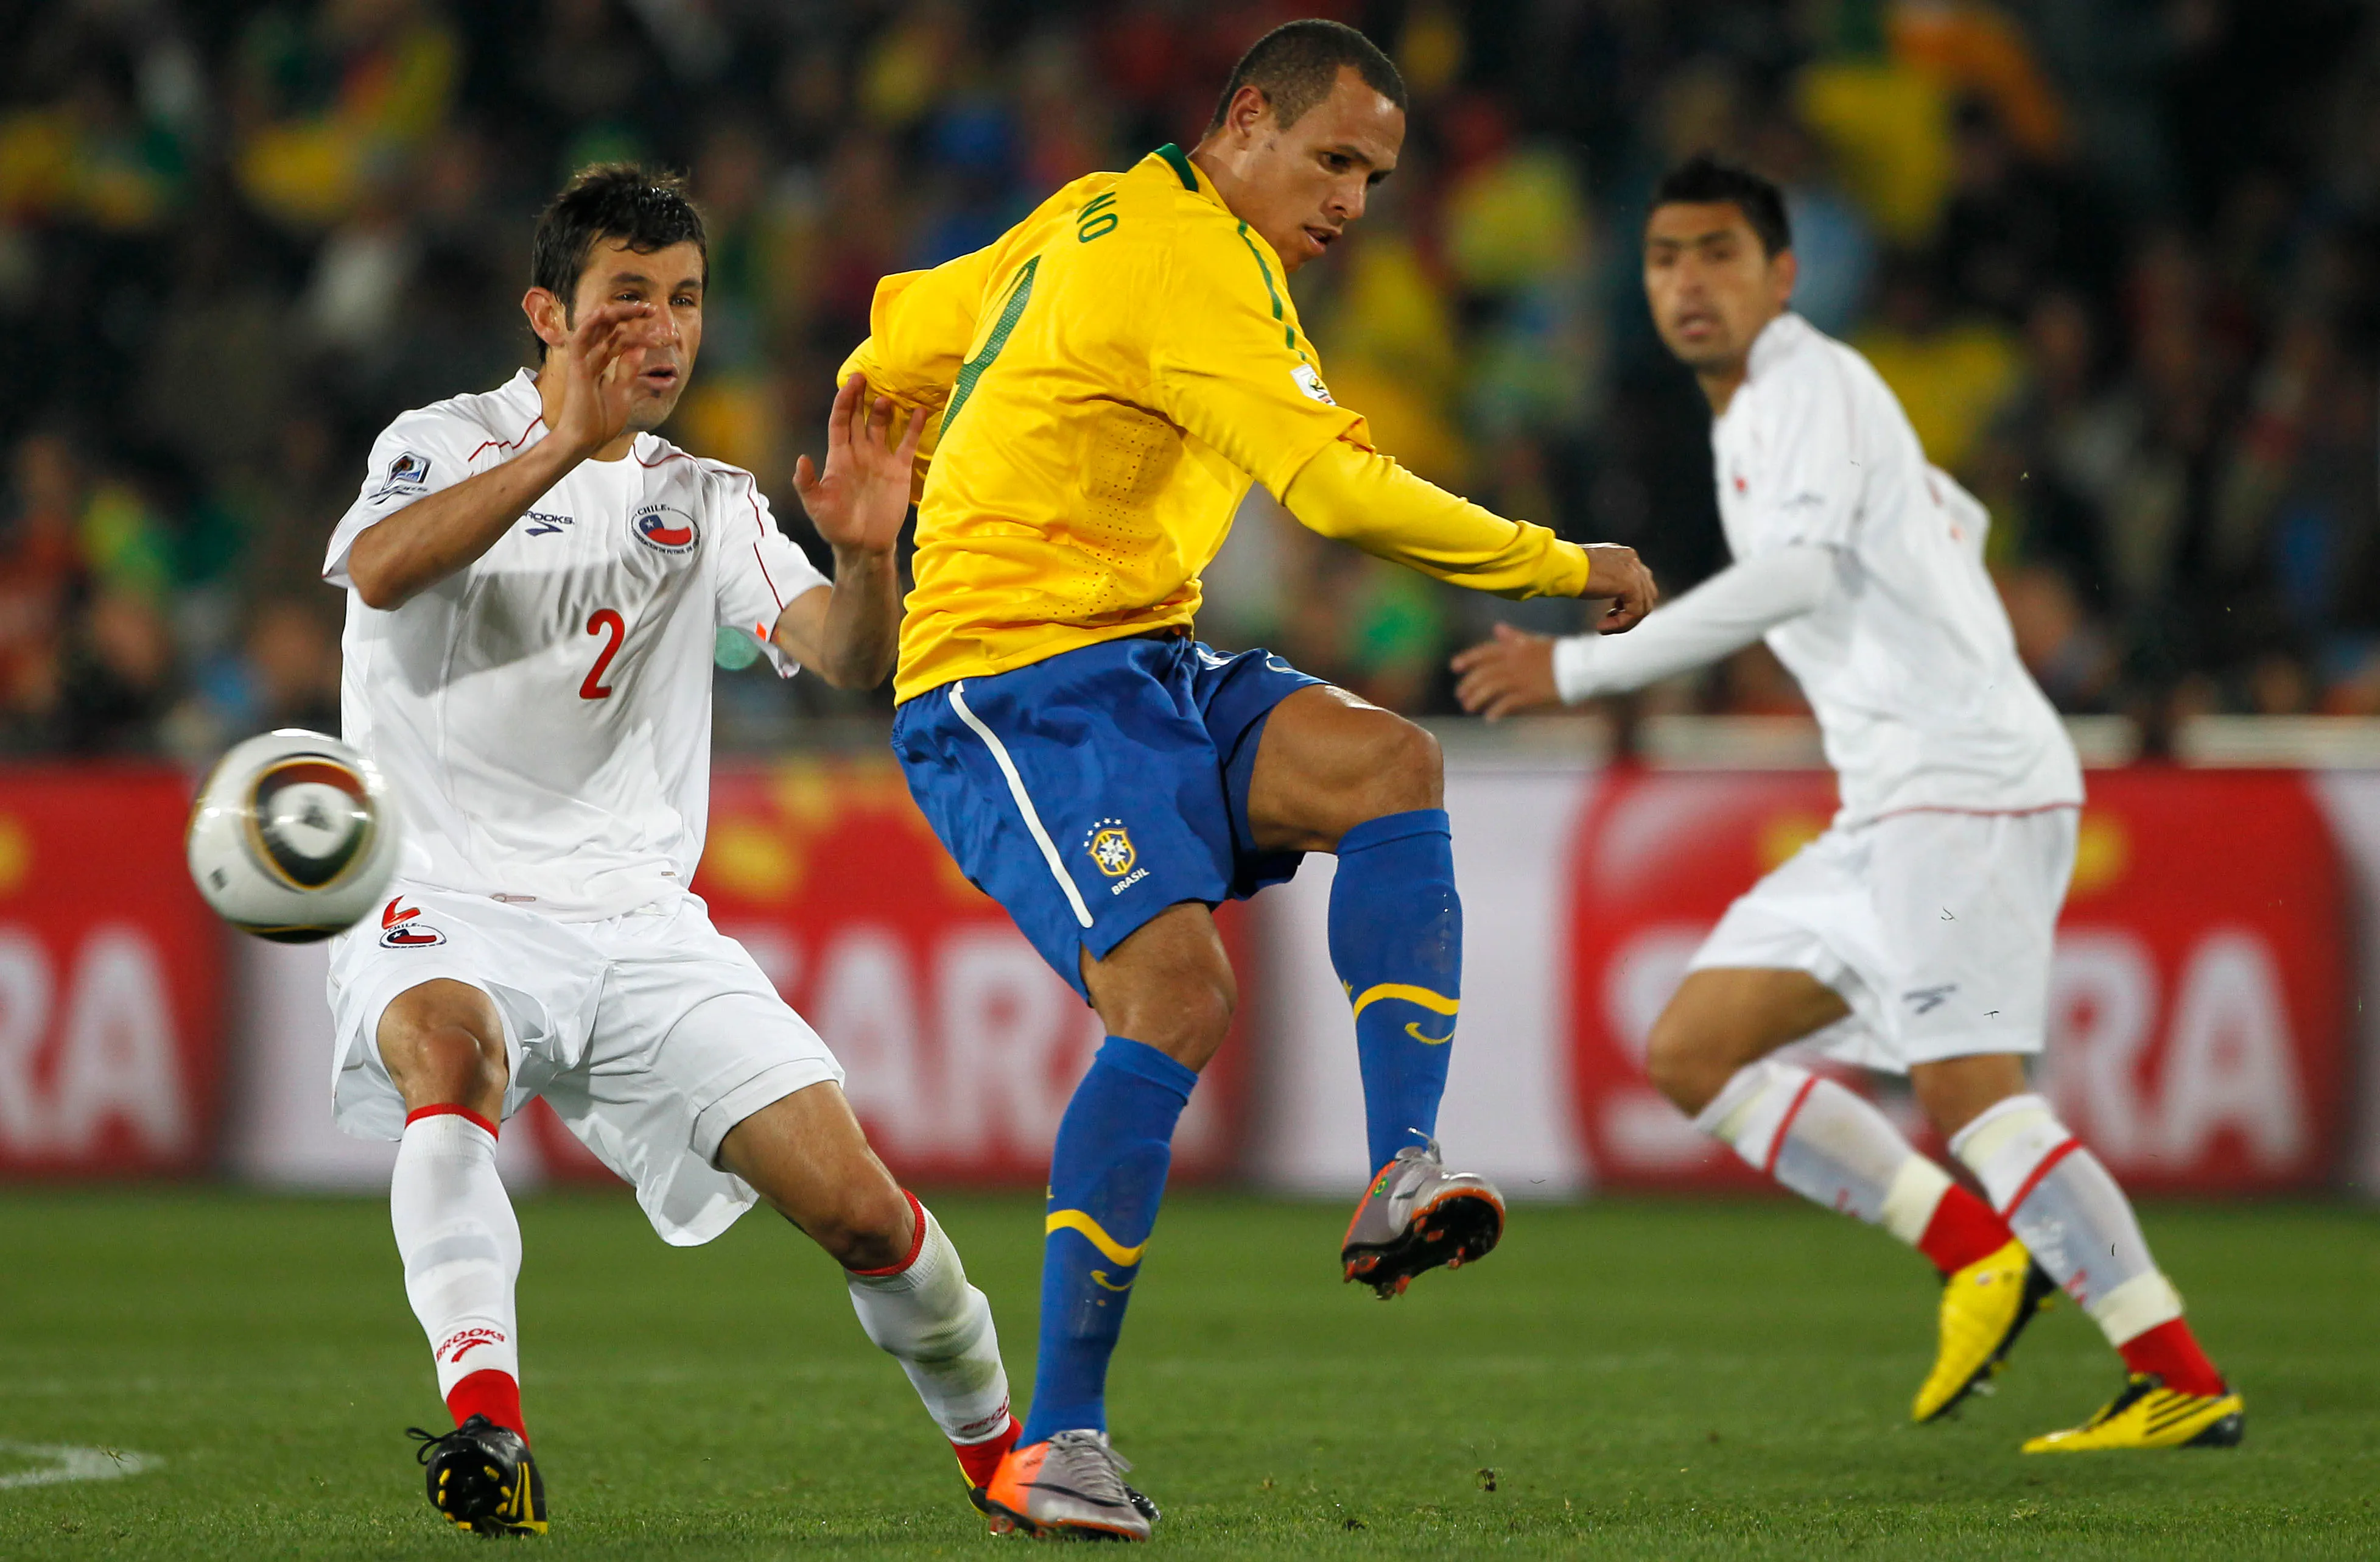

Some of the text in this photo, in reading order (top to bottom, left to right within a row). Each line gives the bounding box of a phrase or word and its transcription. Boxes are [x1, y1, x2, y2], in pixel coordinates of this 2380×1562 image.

[1076, 191, 1118, 244] NO
[524, 510, 573, 524] ROOKS
[637, 503, 667, 516] CHILE
[579, 608, 625, 700] 2
[1111, 868, 1150, 895] BRASIL
[436, 1328, 505, 1362] BROOKS
